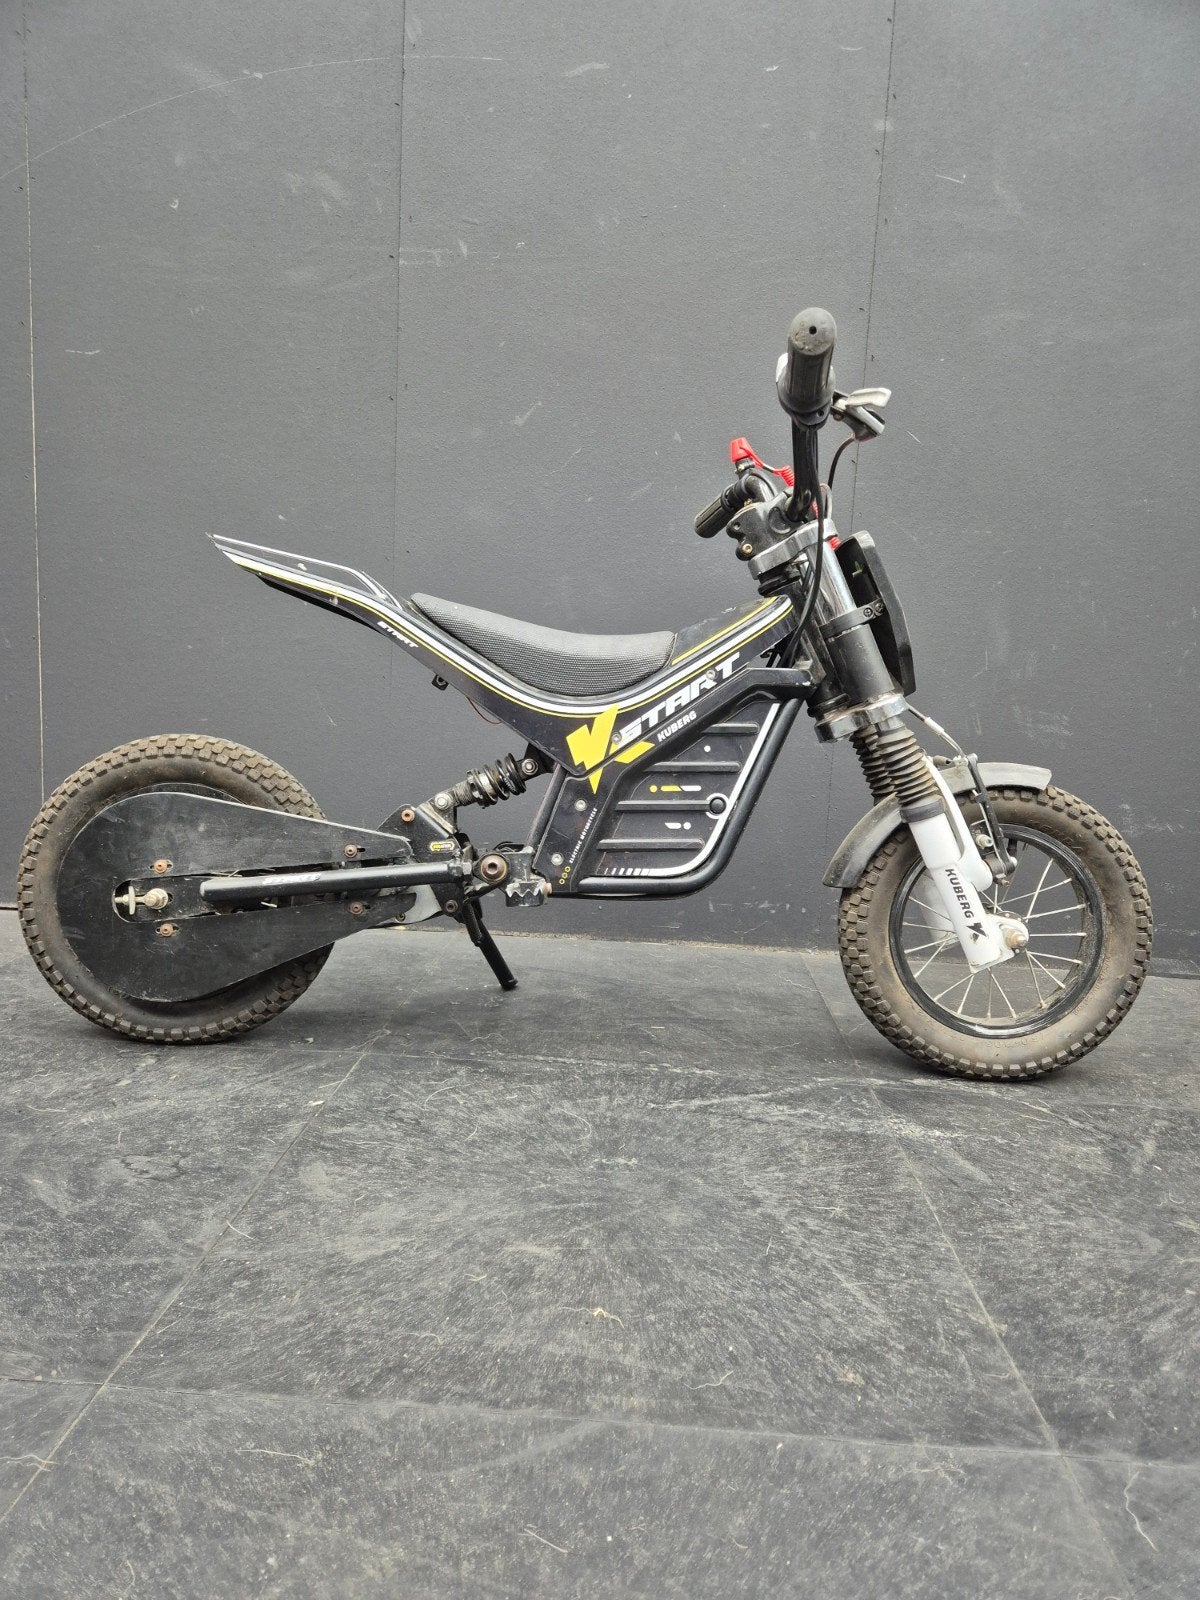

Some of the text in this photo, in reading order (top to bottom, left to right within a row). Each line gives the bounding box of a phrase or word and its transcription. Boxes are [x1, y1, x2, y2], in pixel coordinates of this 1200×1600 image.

[616, 651, 740, 749] START
[656, 710, 697, 742] KUBERG
[569, 807, 598, 864] ELECTRIC MOTORCYCLE
[945, 868, 974, 919] KUBERG
